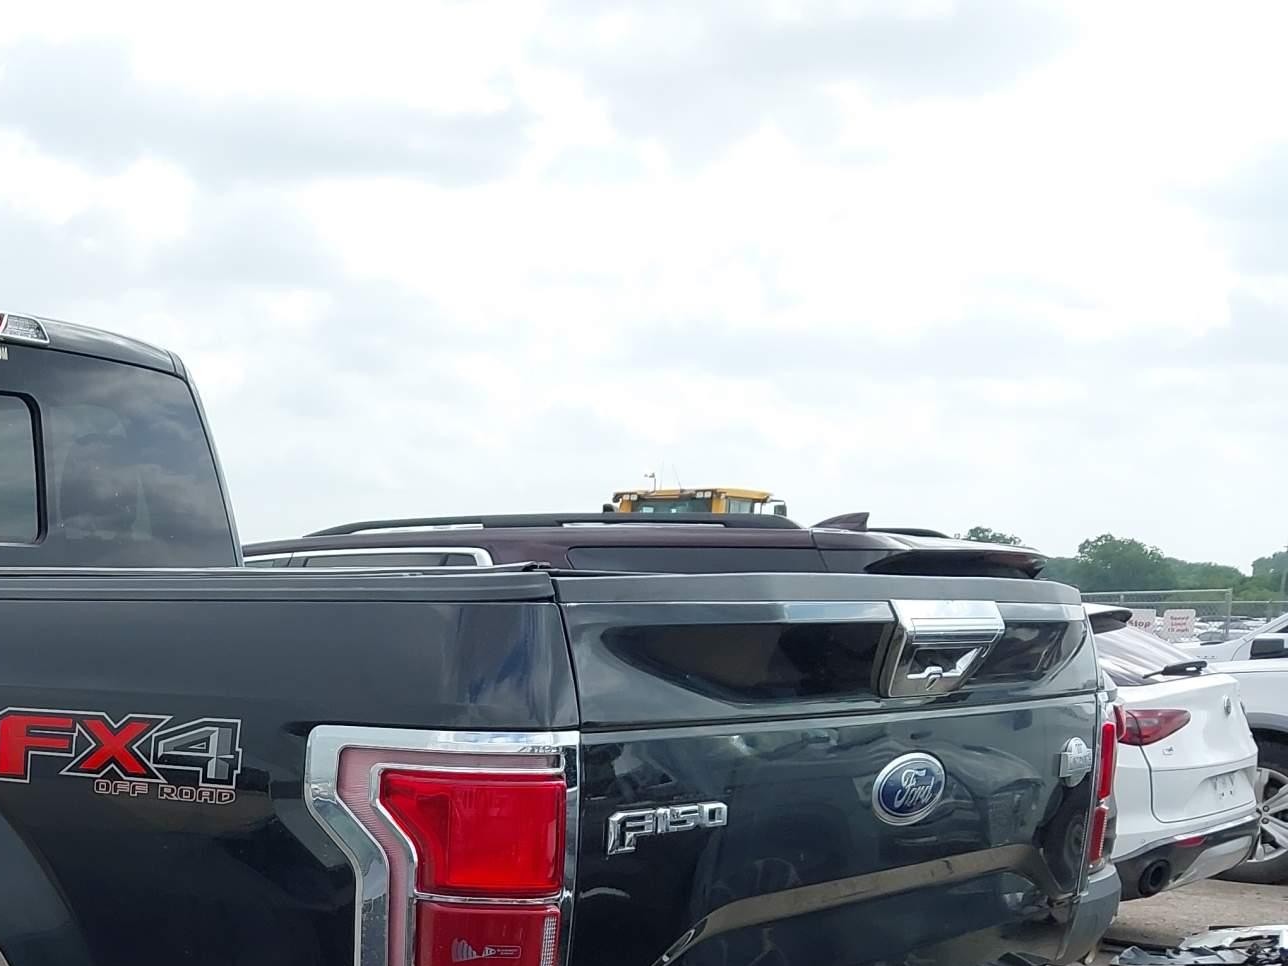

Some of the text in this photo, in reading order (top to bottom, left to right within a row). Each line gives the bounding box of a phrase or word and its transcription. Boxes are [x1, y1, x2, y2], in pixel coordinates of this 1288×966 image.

[93, 779, 237, 805] OFF ROAD
[894, 768, 935, 809] Ford
